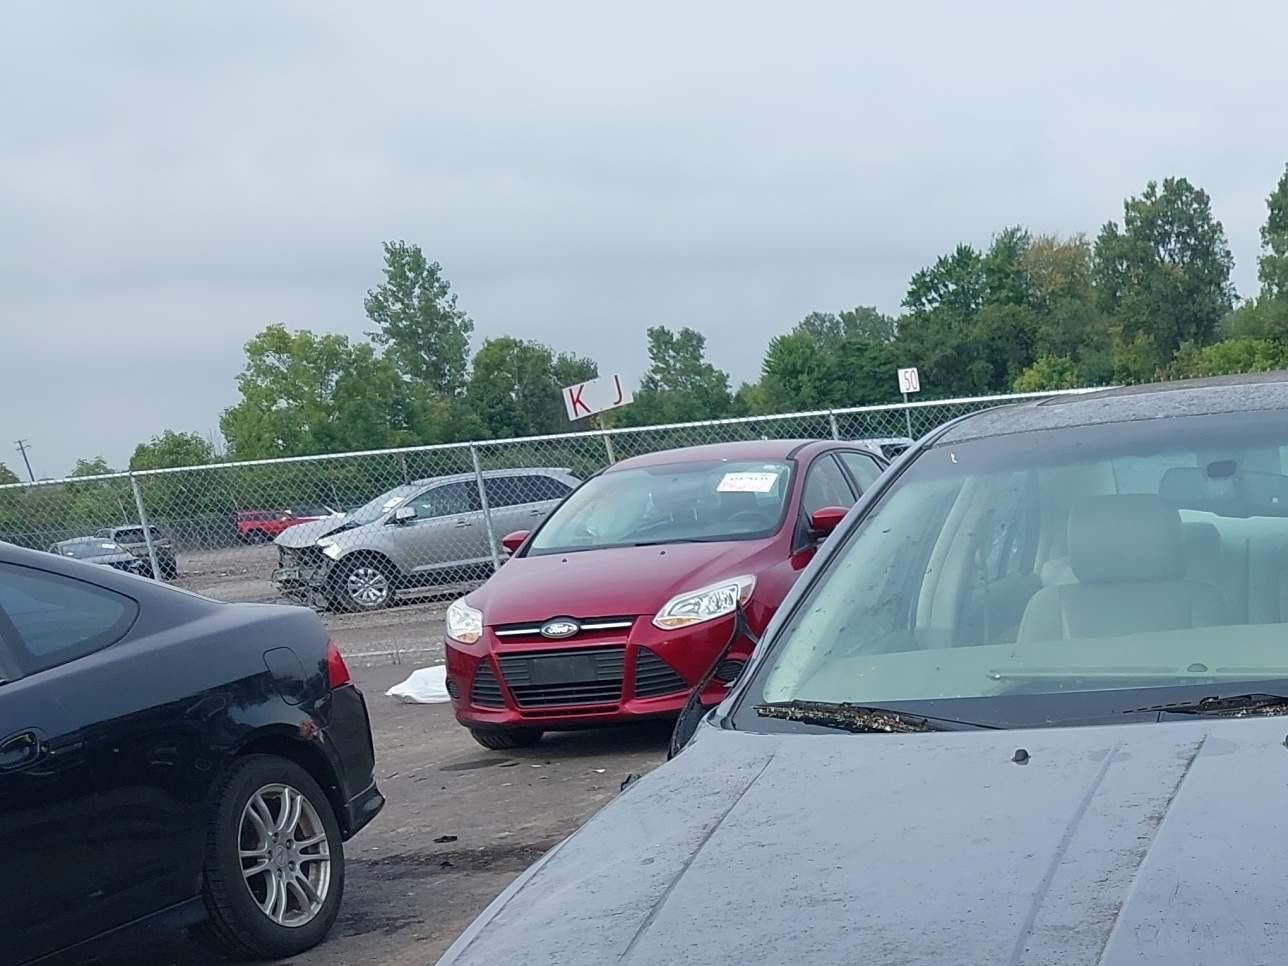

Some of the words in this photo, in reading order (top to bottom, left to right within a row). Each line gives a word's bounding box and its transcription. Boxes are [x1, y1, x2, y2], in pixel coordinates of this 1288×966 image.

[569, 384, 592, 417] K
[613, 374, 623, 405] J
[903, 370, 917, 391] 50
